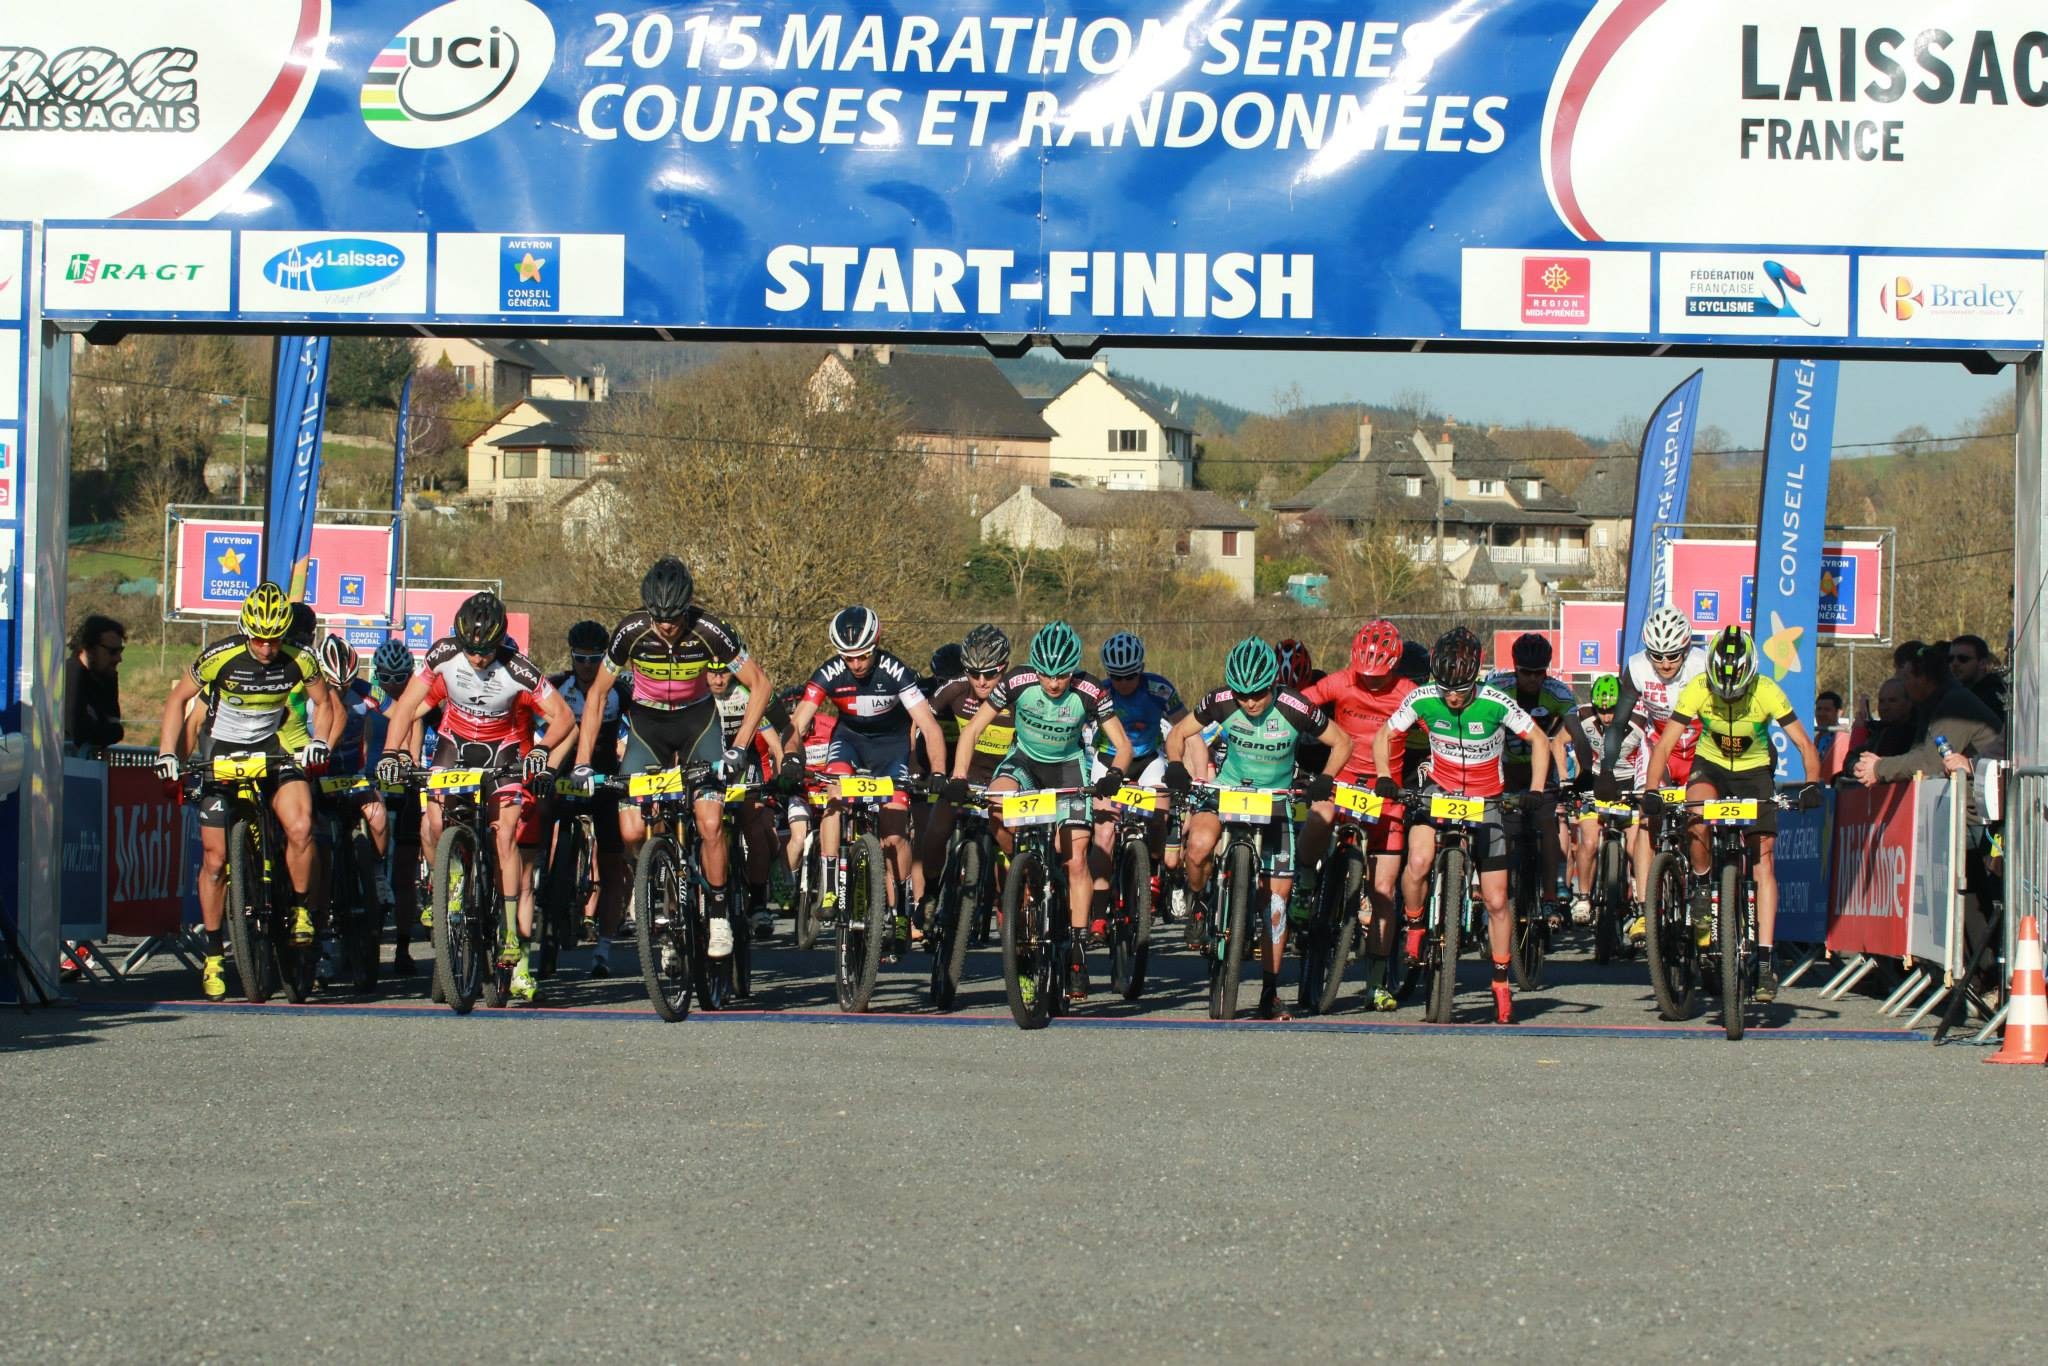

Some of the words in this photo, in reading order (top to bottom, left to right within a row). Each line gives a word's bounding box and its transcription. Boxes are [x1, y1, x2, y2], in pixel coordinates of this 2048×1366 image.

[585, 13, 758, 70] 2015
[775, 15, 1192, 75] MARATHON
[1742, 24, 2048, 107] LAISSAC
[0, 101, 199, 132] AISSAGAIS
[578, 83, 904, 146] COURSES
[918, 89, 1007, 147] ET
[1019, 82, 1509, 155] RANDONNÉES
[1740, 117, 1904, 162] FRANCE
[508, 241, 552, 249] AVEYRON
[327, 250, 399, 267] Laissac
[766, 245, 1313, 319] START-FINISH
[1690, 269, 1754, 281] FÉDÉRATION
[508, 290, 551, 298] CONSEIL
[1690, 282, 1754, 295] FRANÇAISE
[508, 298, 551, 307] GÉNÉRAL
[1931, 282, 2024, 315] Braley
[1698, 301, 1754, 312] CYCLISME
[1789, 359, 1816, 452] GÉNÉ
[1780, 463, 1805, 597] CONSEIL
[212, 536, 253, 545] AVEYRON
[1820, 560, 1849, 568] EYRON
[211, 580, 250, 588] CONSEIL
[211, 588, 249, 597] GÉNÉRAL
[1820, 603, 1848, 612] NSEIL
[1819, 611, 1848, 620] NÉRAL
[204, 641, 236, 659] TOPEAK
[426, 642, 457, 662] TEXPA
[509, 660, 538, 684] TEXPA
[821, 658, 847, 682] IAM
[880, 655, 905, 682] IAM
[241, 682, 293, 692] TOPEAK
[1079, 680, 1100, 699] NDA
[872, 697, 894, 708] IAM
[1278, 693, 1309, 715] KENDA
[1228, 733, 1291, 752] Bianchi
[442, 774, 470, 785] 137
[646, 777, 665, 790] 12
[857, 780, 878, 793] 35
[1019, 799, 1039, 814] 37
[1241, 797, 1249, 811] 1
[1351, 794, 1369, 810] 13
[1447, 803, 1468, 817] 23
[1720, 806, 1741, 817] 25
[114, 802, 172, 902] Midi
[838, 885, 847, 910] SWISS
